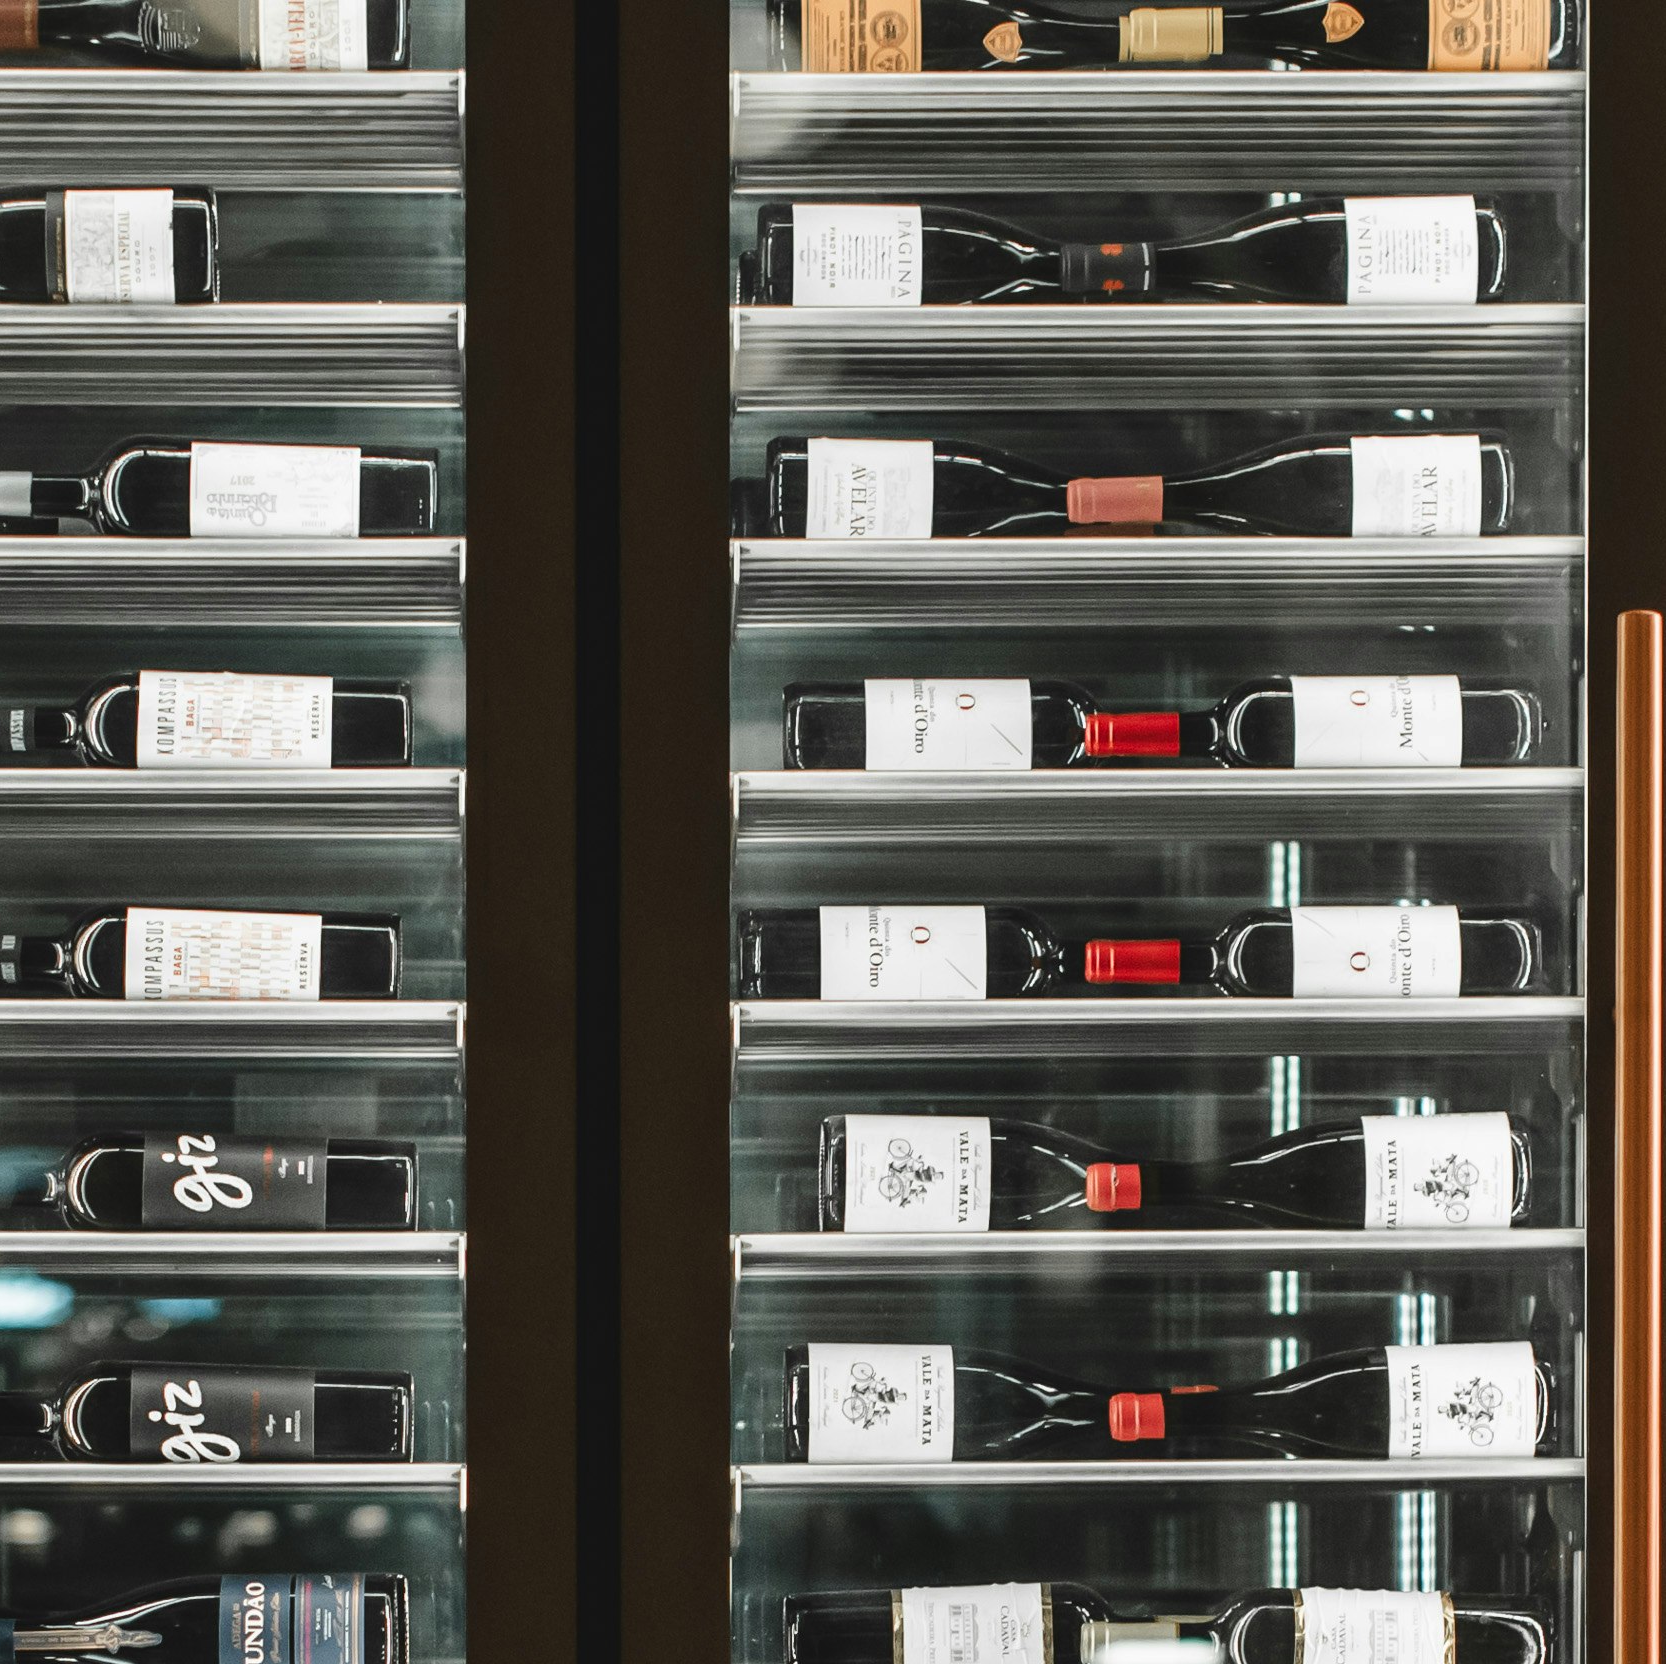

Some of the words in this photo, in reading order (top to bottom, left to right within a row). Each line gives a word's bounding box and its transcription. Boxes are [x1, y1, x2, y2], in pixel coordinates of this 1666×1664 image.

[896, 220, 915, 298] PÁGINA
[1354, 214, 1372, 294] PÁGINA
[849, 463, 867, 538] AVELAR
[1421, 465, 1438, 537] AVELAR
[156, 677, 177, 756] KOMPASSUS
[186, 698, 196, 728] BAGA
[310, 693, 320, 740] RESERVA
[1398, 698, 1413, 749] Monte
[1397, 913, 1413, 958] d'Oiro
[173, 946, 183, 977] BAGA
[298, 941, 309, 990] RESERVA
[869, 936, 885, 988] d'Oiro
[959, 1130, 969, 1164] VALE
[1386, 1139, 1397, 1180] MATA
[160, 1133, 252, 1212] giz
[958, 1184, 968, 1224] MATA
[921, 1355, 931, 1386] VALE
[1411, 1363, 1421, 1400] MATA
[148, 1380, 241, 1464] giz
[921, 1405, 932, 1446] MATA
[999, 1604, 1012, 1660] CADAVAL
